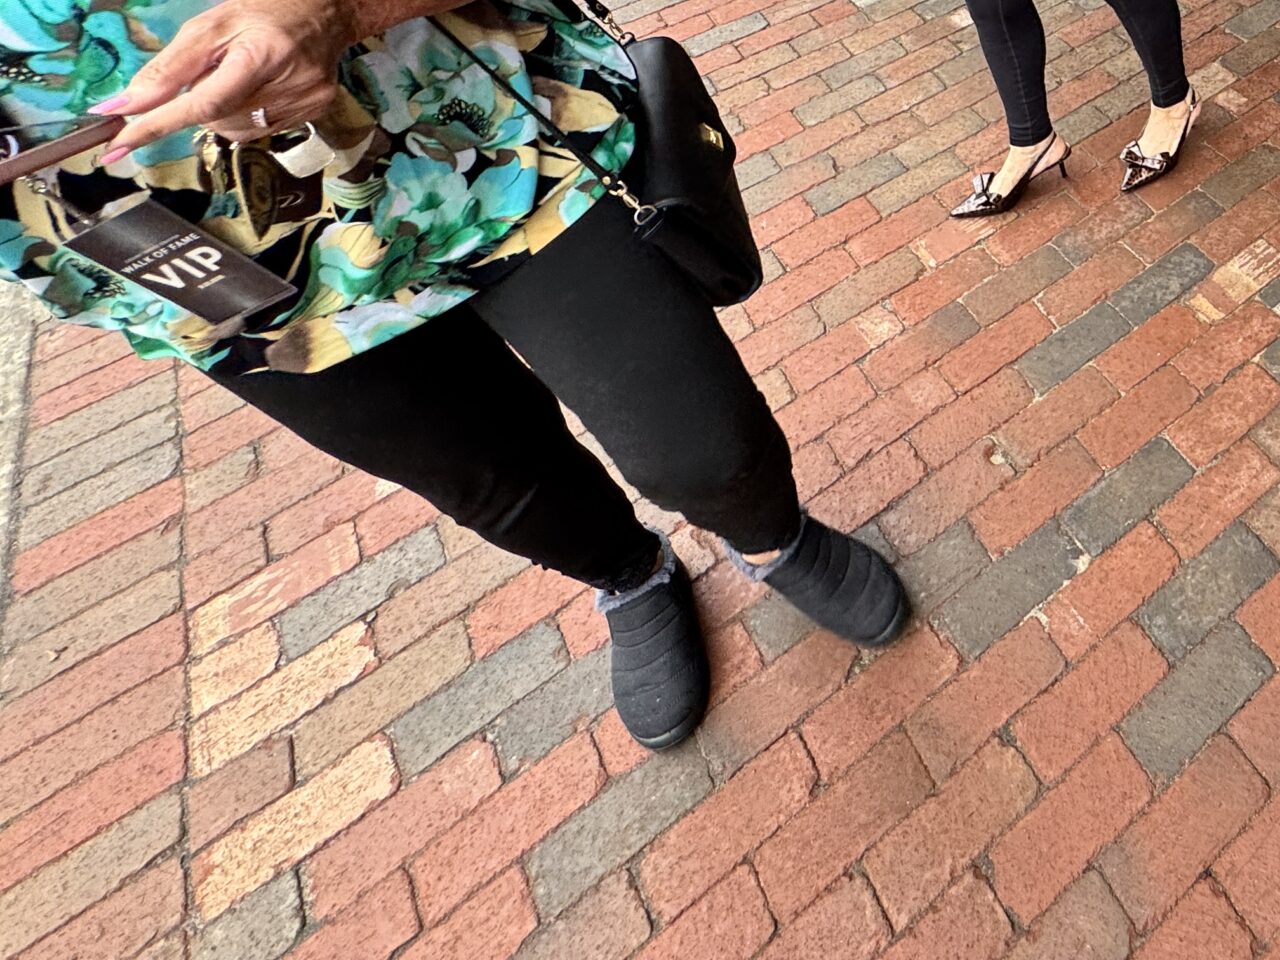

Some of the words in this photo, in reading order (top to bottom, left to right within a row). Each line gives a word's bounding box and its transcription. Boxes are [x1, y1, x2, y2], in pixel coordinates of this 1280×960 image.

[120, 255, 155, 274] WALK
[152, 247, 169, 259] OF
[168, 232, 201, 251] FAME
[141, 246, 223, 289] VIP
